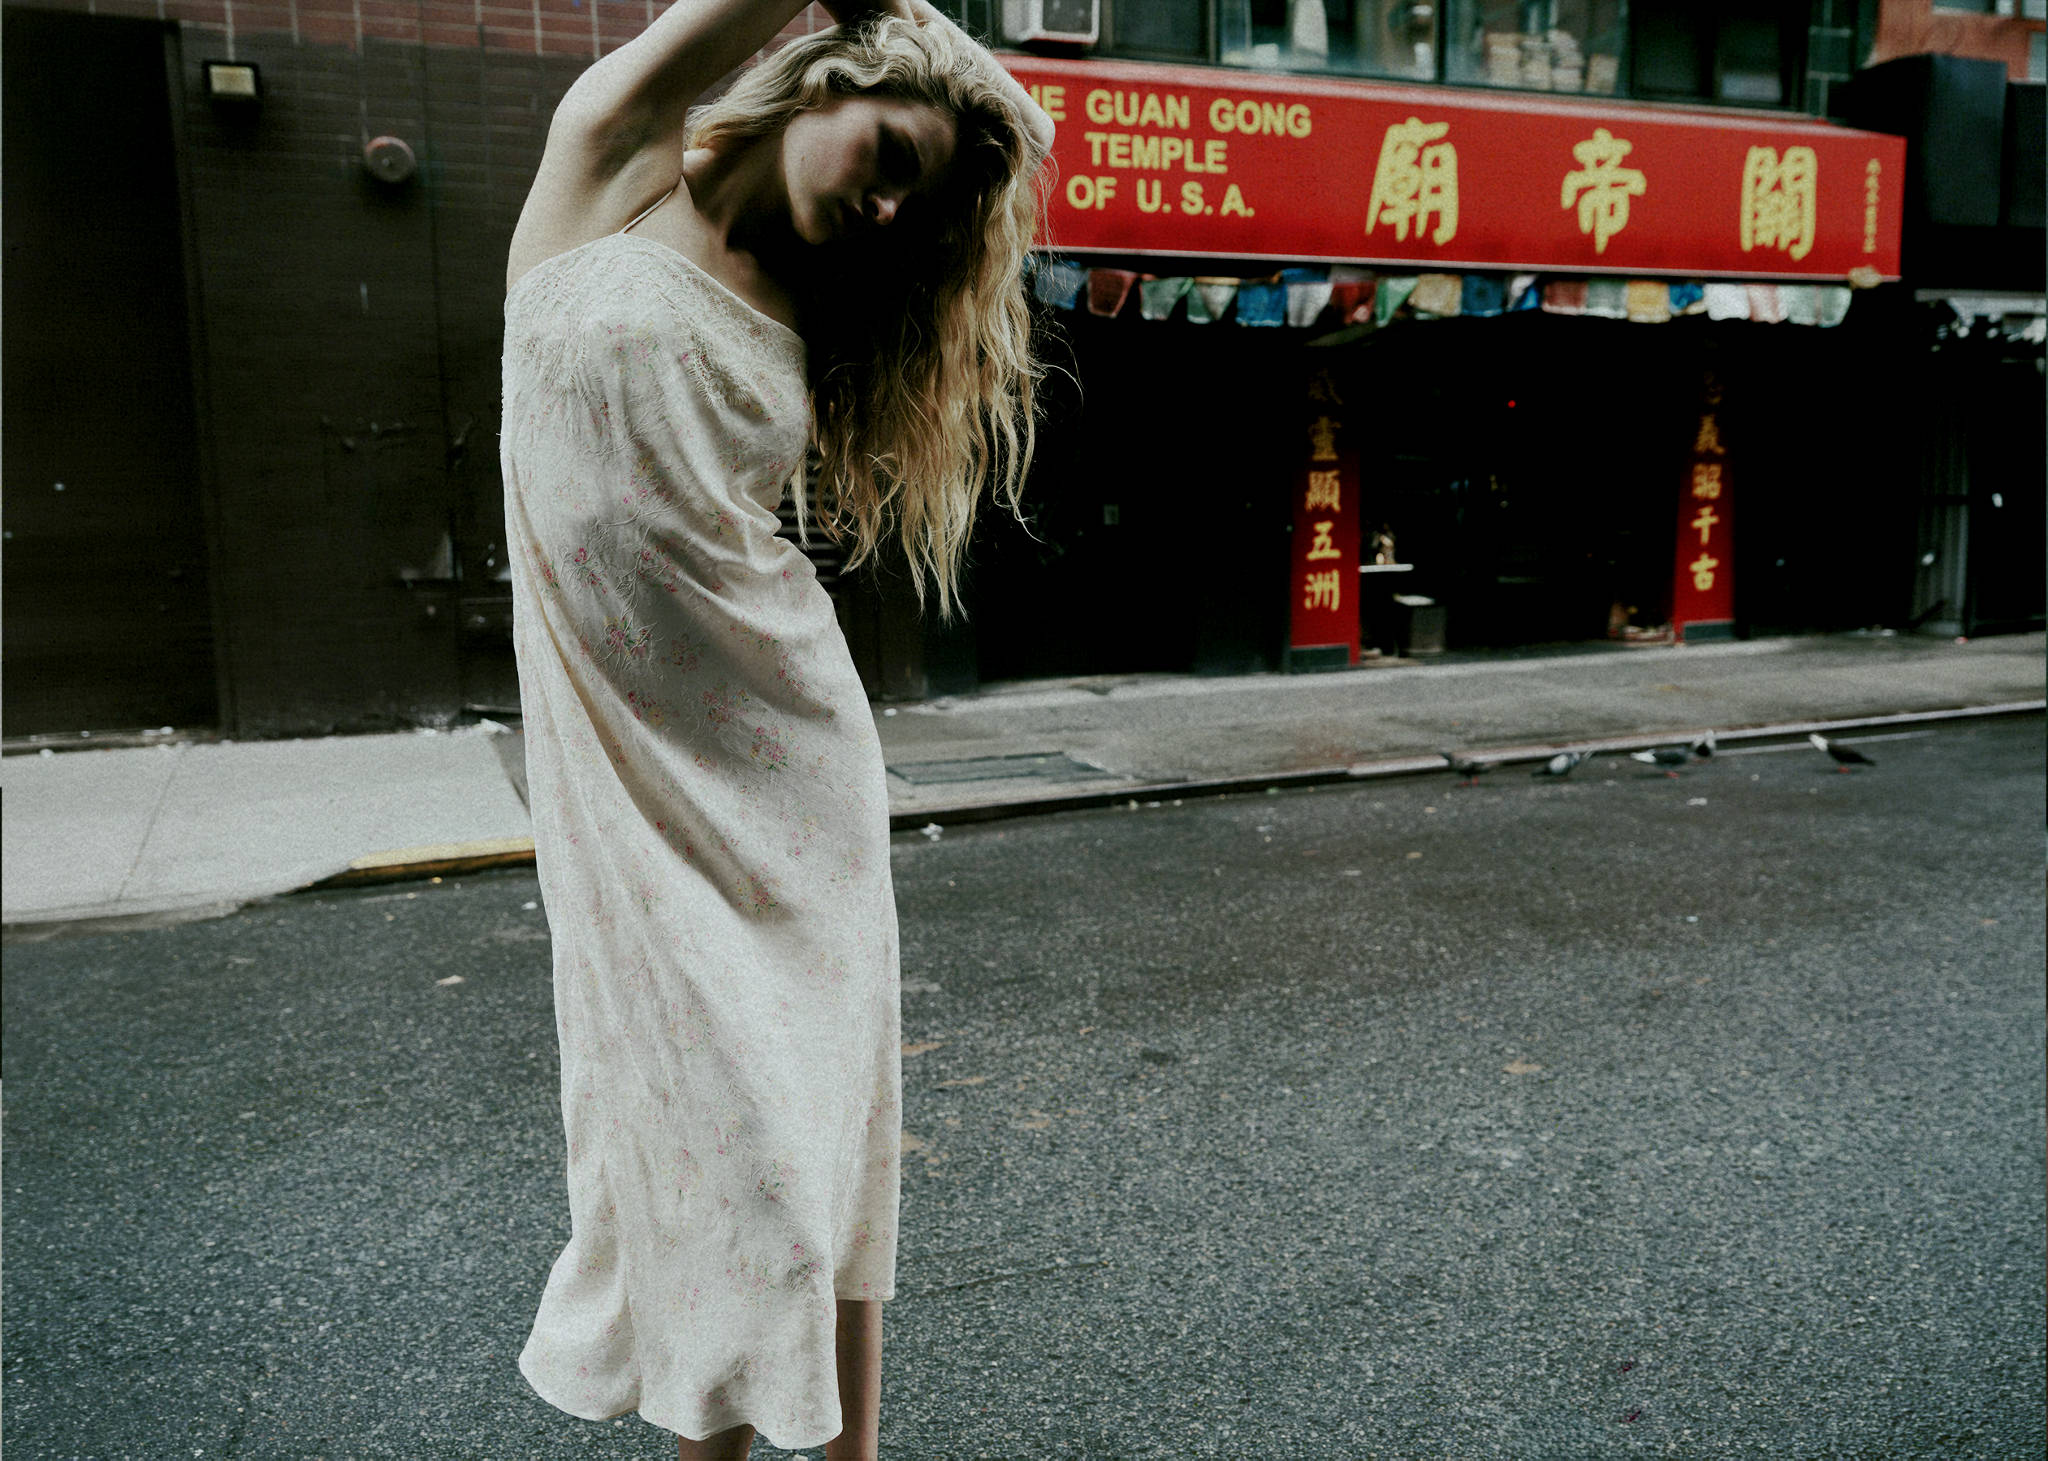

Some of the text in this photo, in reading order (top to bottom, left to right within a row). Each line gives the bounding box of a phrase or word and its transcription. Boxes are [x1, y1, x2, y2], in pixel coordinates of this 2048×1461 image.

[1086, 89, 1190, 130] GUAN
[1209, 98, 1312, 138] GONG
[1084, 132, 1228, 174] TEMPLE
[1066, 174, 1118, 210] OF
